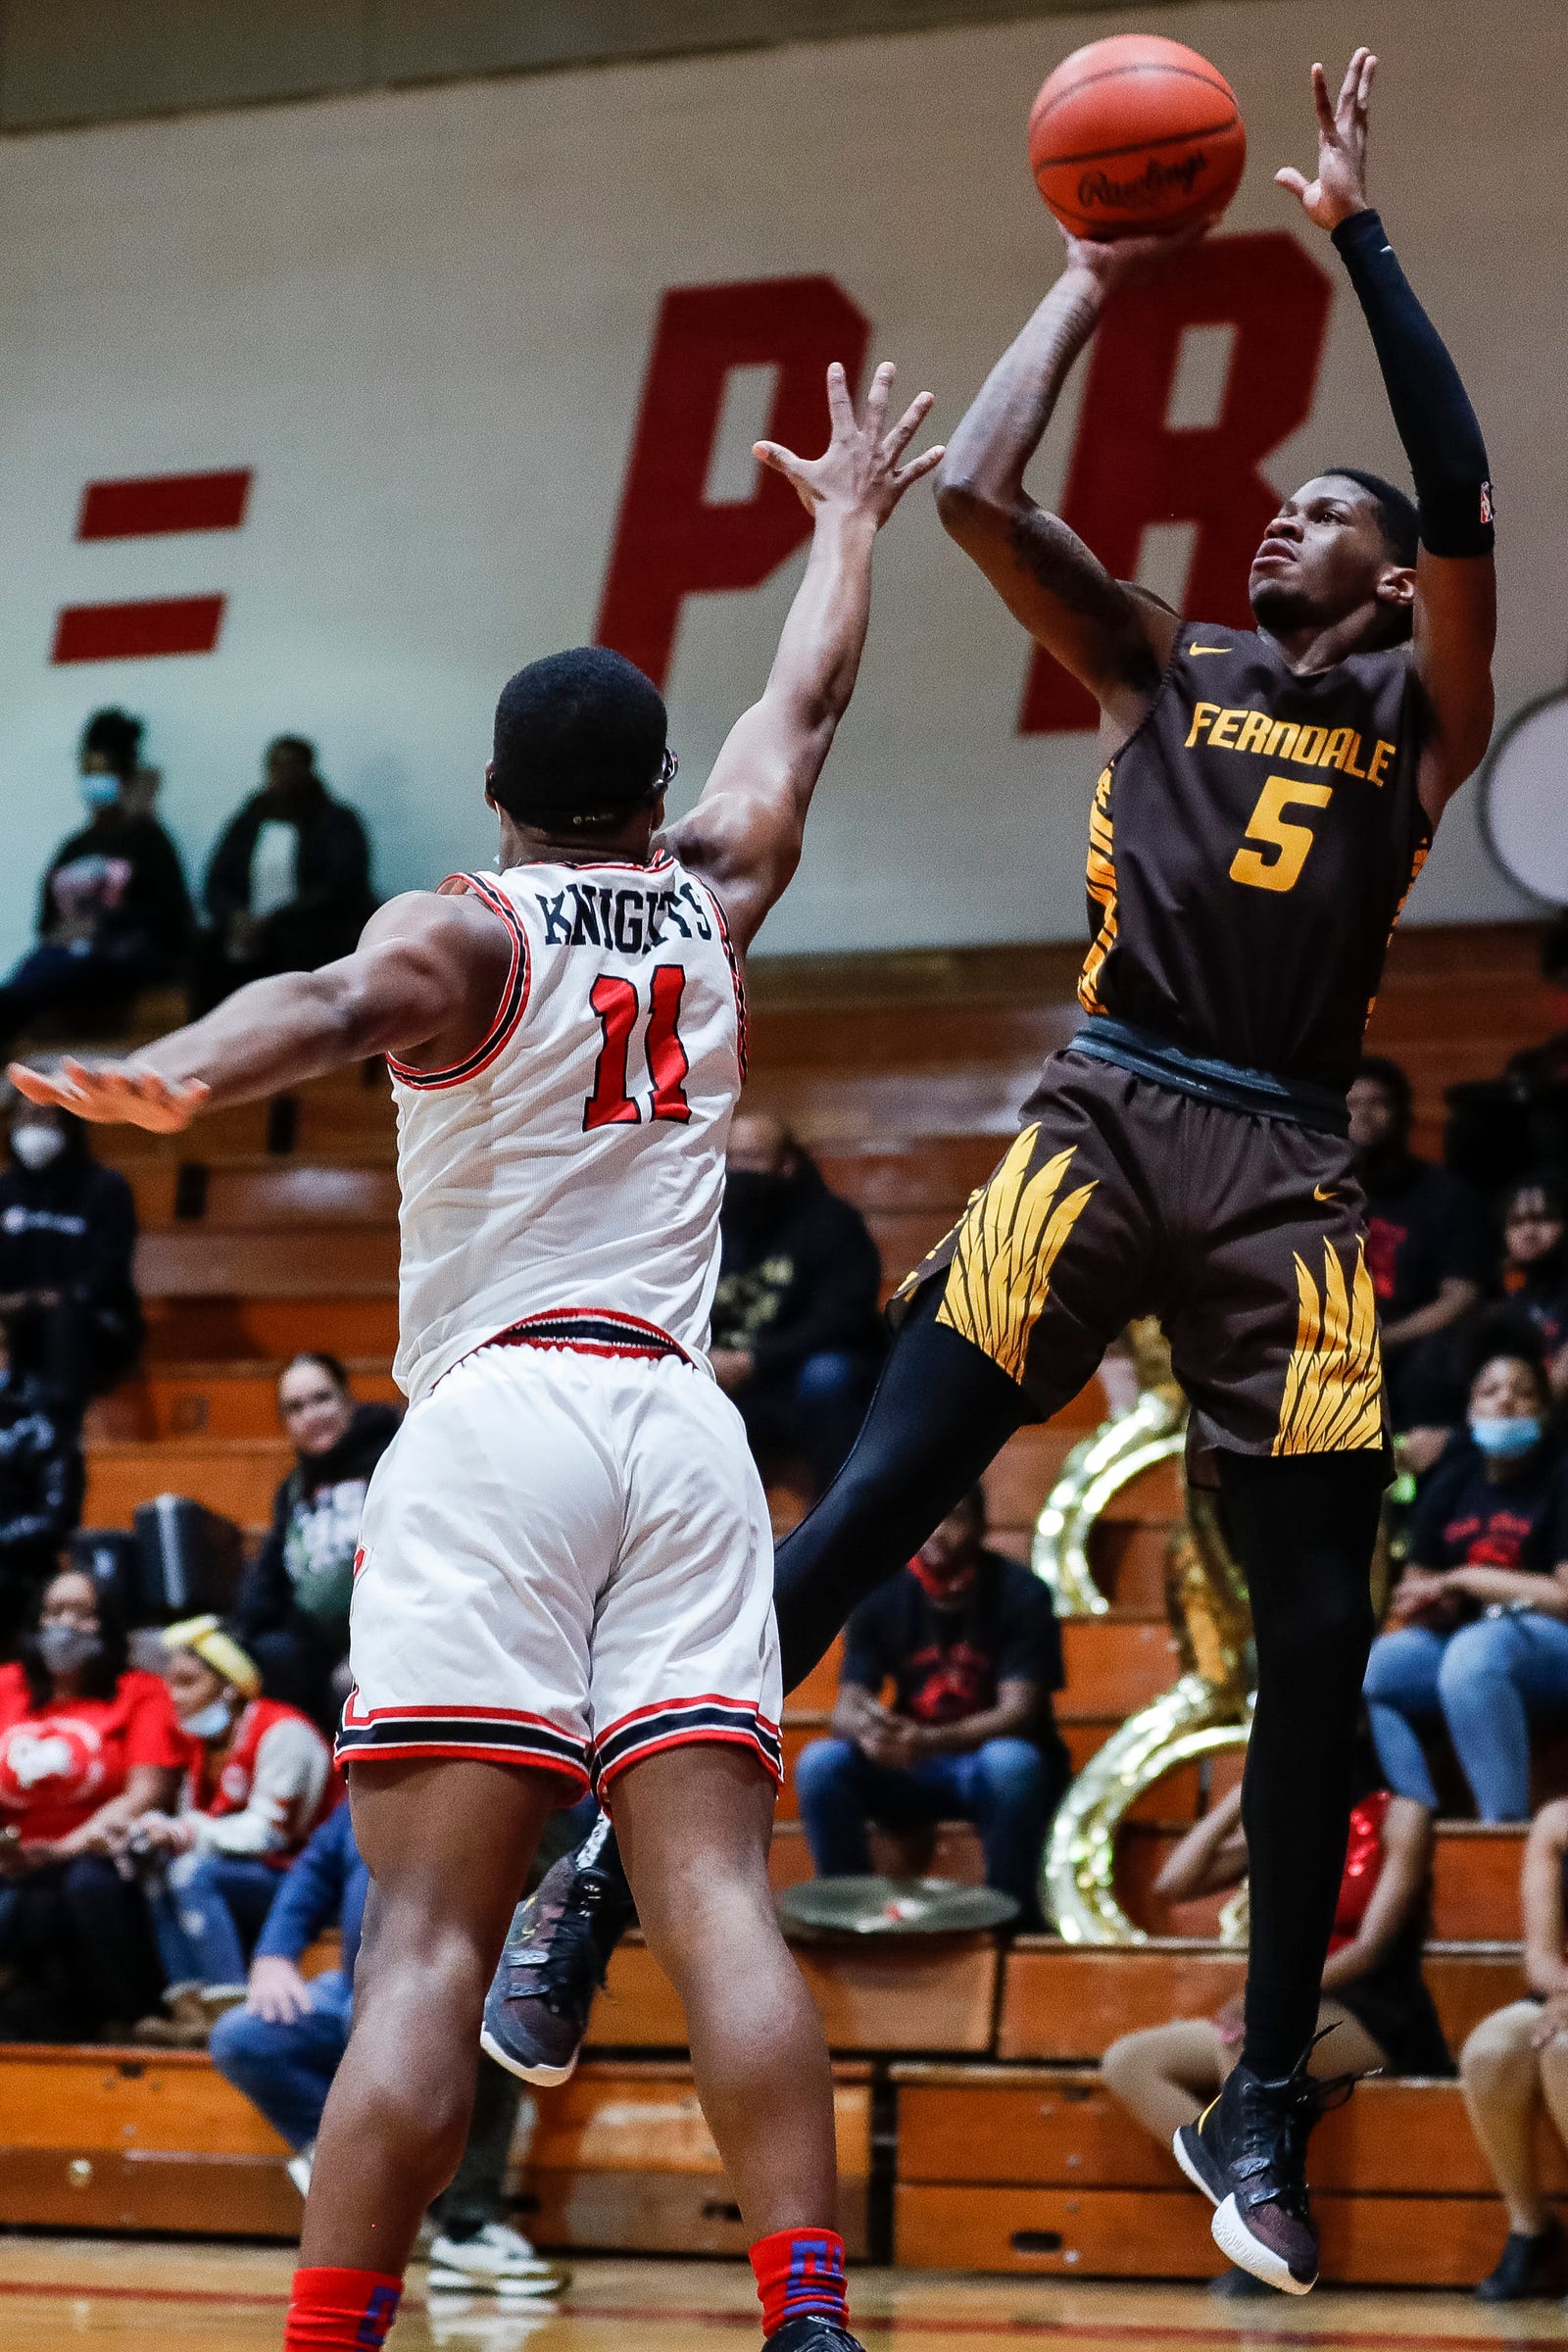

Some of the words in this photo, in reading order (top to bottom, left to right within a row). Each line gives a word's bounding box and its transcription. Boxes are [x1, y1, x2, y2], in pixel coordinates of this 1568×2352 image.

[1077, 150, 1208, 208] Rawlings
[1184, 702, 1396, 788] FERNDALE
[1229, 774, 1334, 893] 5
[582, 964, 692, 1133] 11
